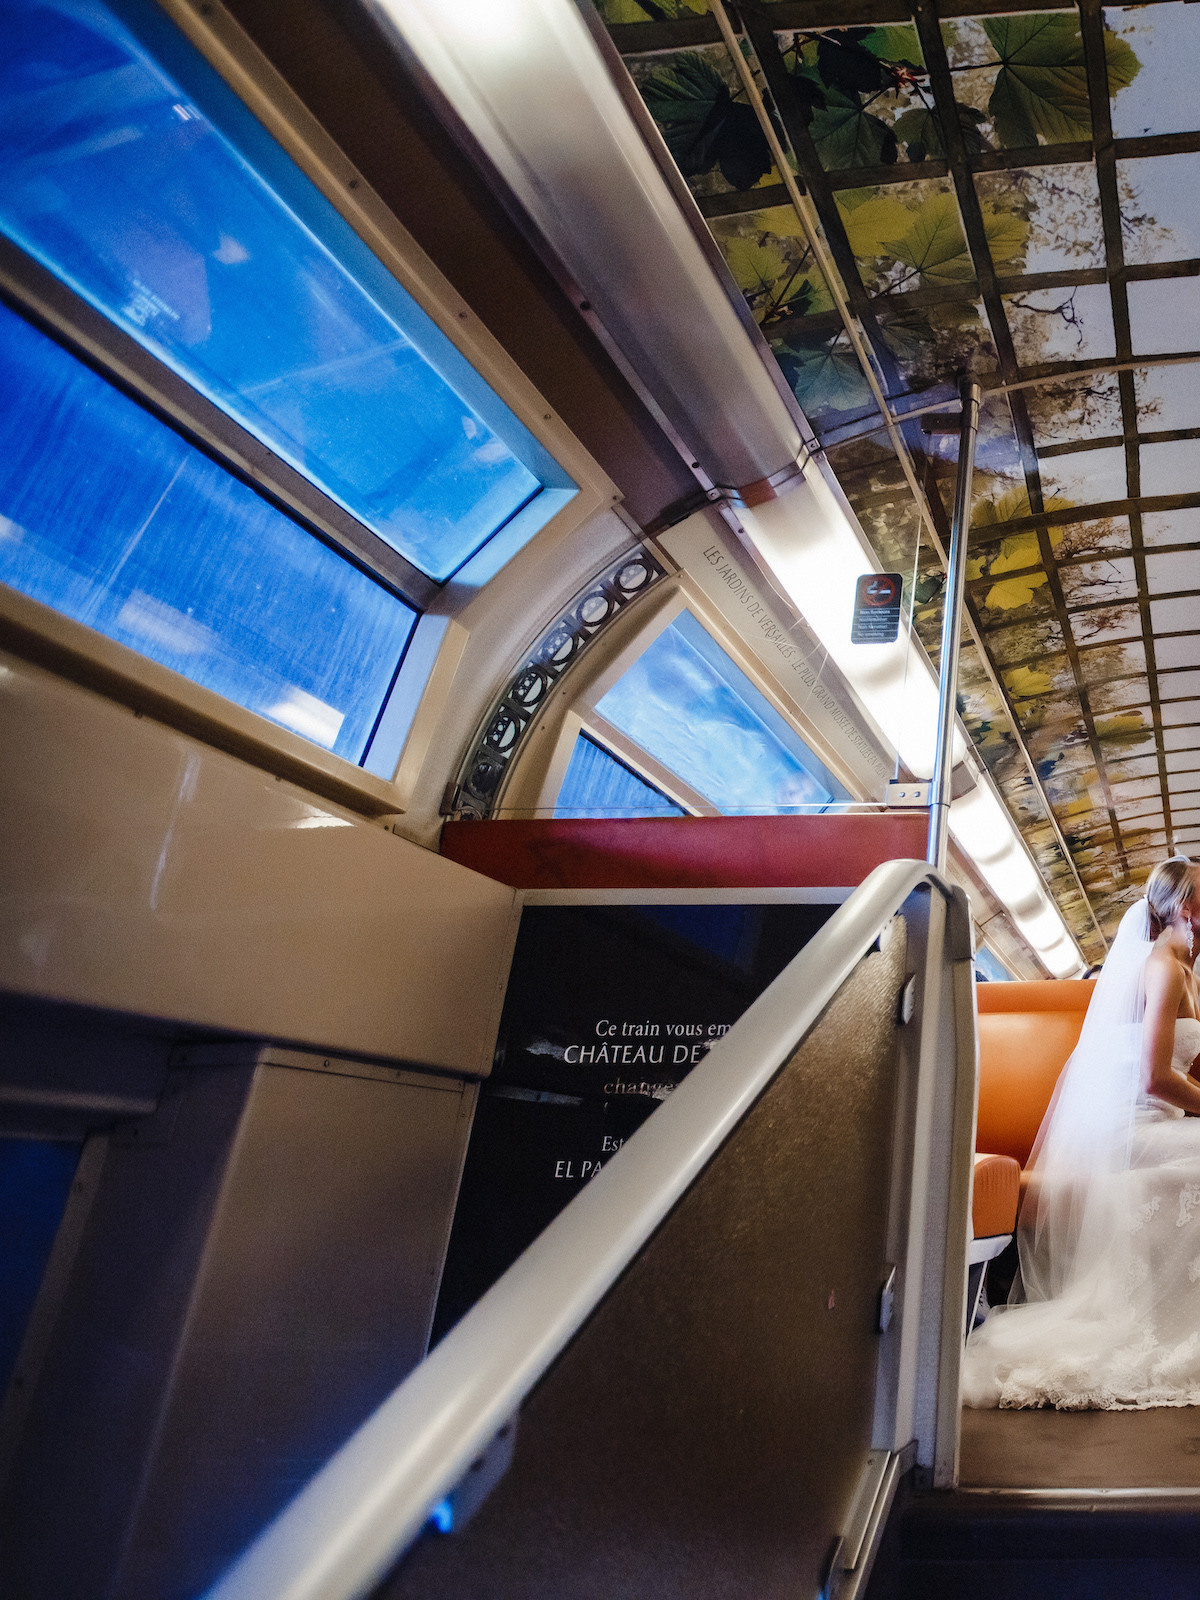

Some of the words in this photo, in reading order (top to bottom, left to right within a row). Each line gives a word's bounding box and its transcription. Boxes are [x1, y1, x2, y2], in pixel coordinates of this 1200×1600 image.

[702, 545, 723, 565] LES
[715, 564, 754, 604] JARDINS
[747, 601, 763, 617] DE
[759, 615, 795, 658] VERSAILLES
[791, 660, 804, 671] LE
[798, 668, 817, 687] PLUS
[812, 684, 835, 710] GRAND
[595, 1019, 617, 1037] Ce
[622, 1020, 660, 1037] train
[666, 1024, 703, 1037] vous
[707, 1023, 732, 1036] em
[564, 1041, 664, 1064] CHÂTEAU
[673, 1045, 701, 1064] DE
[602, 1135, 625, 1152] Est
[554, 1160, 575, 1178] EL
[581, 1160, 602, 1178] PA
